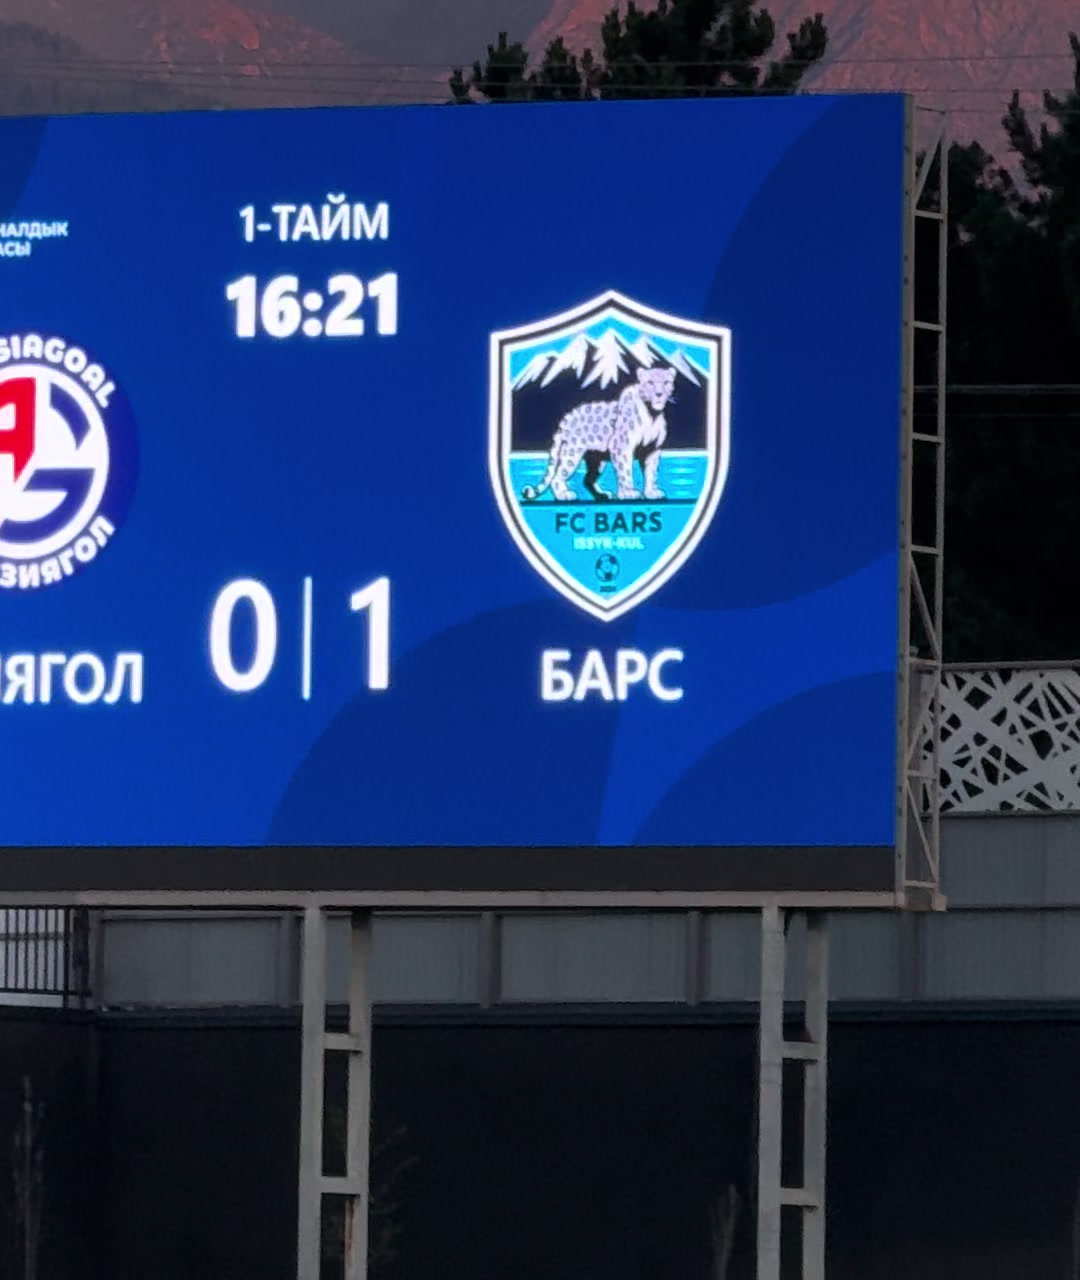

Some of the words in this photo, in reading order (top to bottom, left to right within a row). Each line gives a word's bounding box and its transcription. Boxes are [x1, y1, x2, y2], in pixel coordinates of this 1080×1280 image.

[239, 192, 390, 243] 1-ТАЙМ
[226, 272, 398, 338] 16:21
[555, 512, 586, 534] FC
[594, 511, 663, 533] BARS
[210, 577, 278, 693] 0
[350, 576, 391, 690] 1
[540, 648, 685, 702] БАРС
